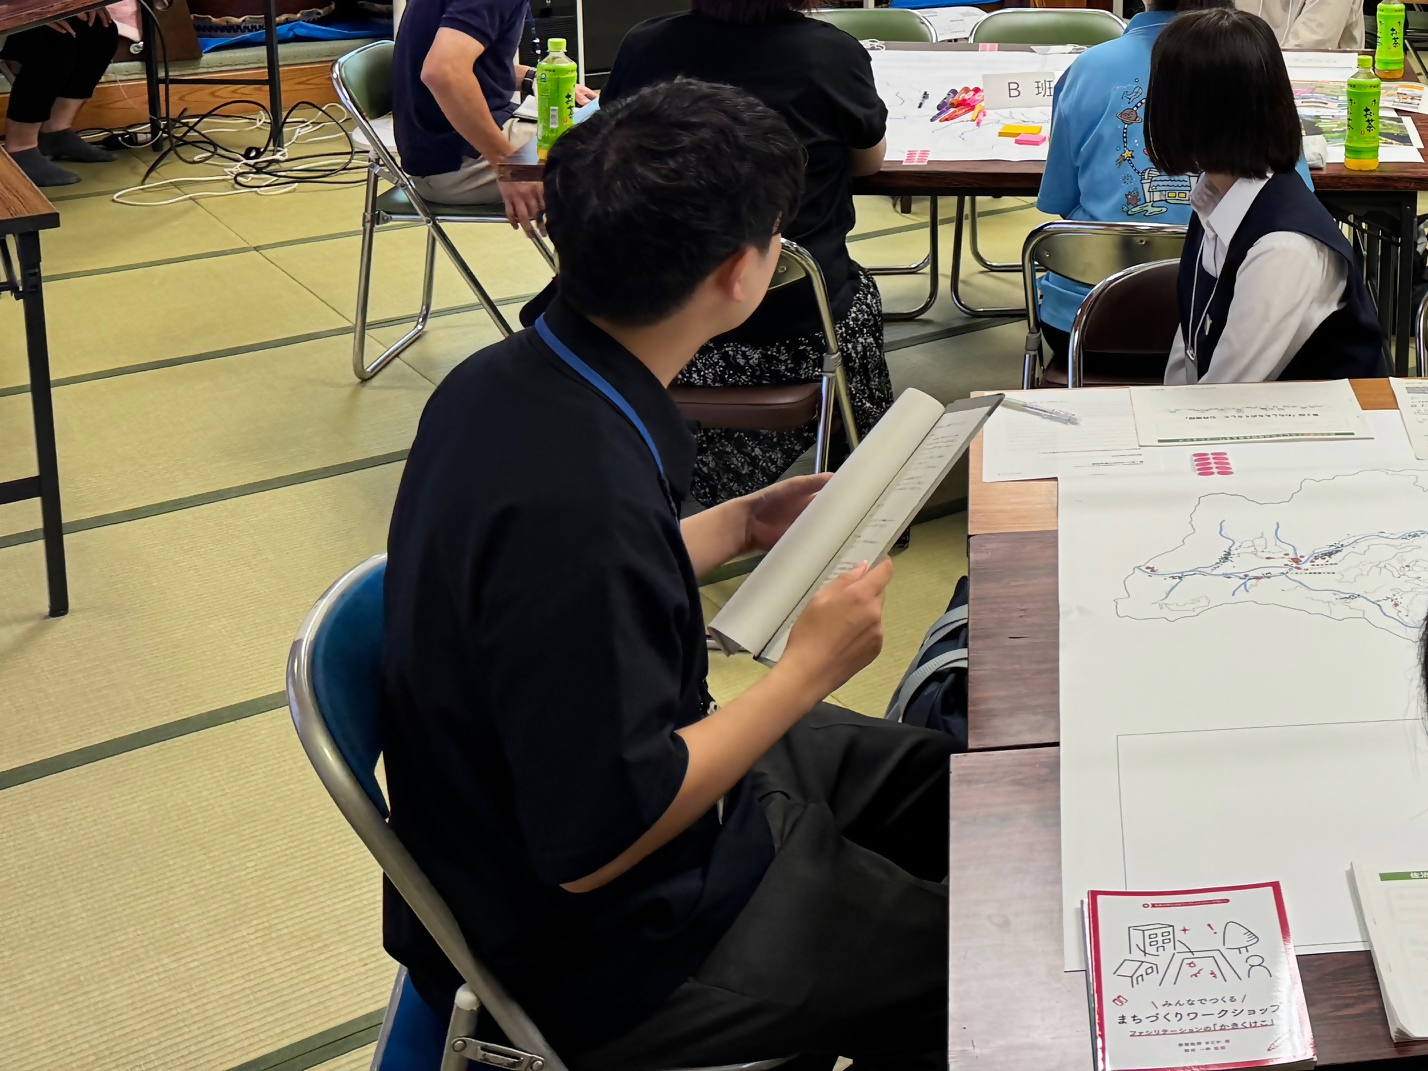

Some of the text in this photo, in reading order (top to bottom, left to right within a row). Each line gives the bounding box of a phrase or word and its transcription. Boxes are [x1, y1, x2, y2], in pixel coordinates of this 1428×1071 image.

[1007, 78, 1054, 99] B 班
[1363, 106, 1377, 133] お茶
[1161, 995, 1238, 1008] みんなでつくる
